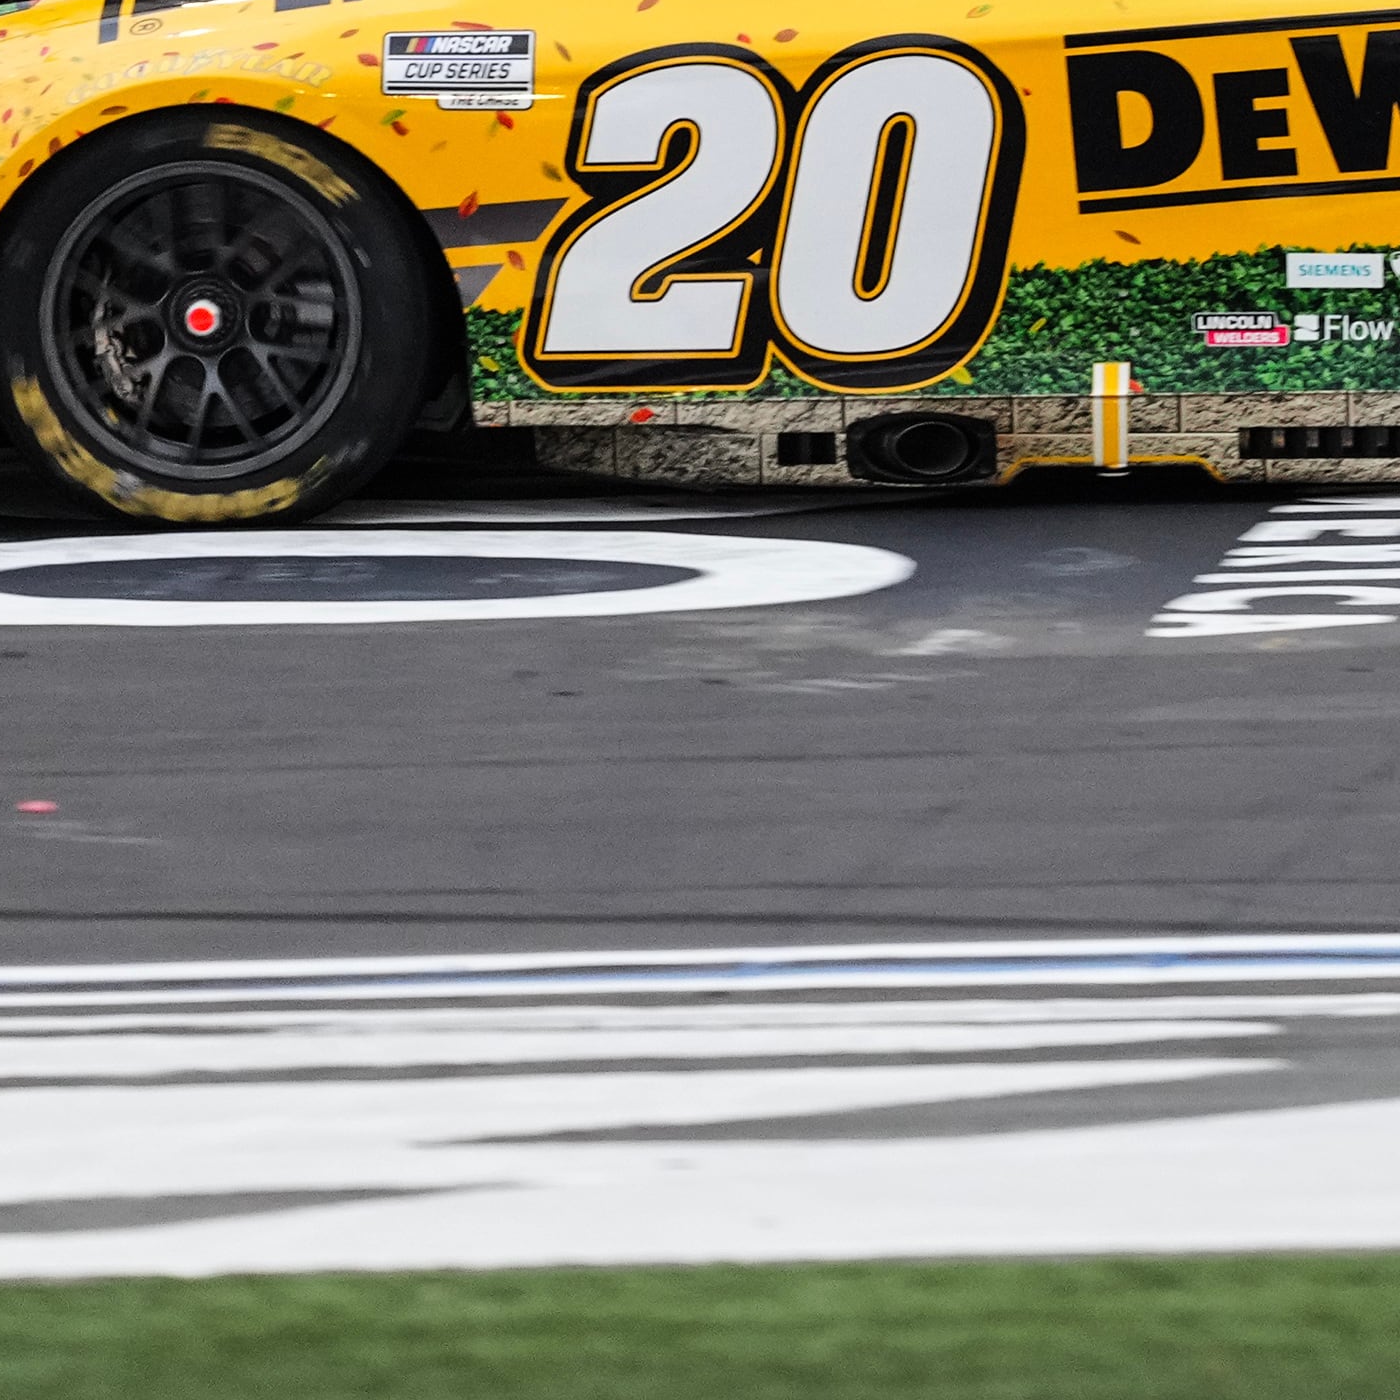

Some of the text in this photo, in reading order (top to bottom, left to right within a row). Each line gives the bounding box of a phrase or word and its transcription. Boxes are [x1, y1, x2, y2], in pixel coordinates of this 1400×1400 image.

[431, 36, 513, 54] NASCAR
[405, 62, 511, 79] CUP SERIES
[450, 94, 473, 106] THE
[525, 40, 1020, 385] 20
[1299, 264, 1372, 277] SIEMENS
[1197, 315, 1273, 330] LINCOLN
[1324, 314, 1395, 341] Flow
[1214, 332, 1280, 343] WELDERS
